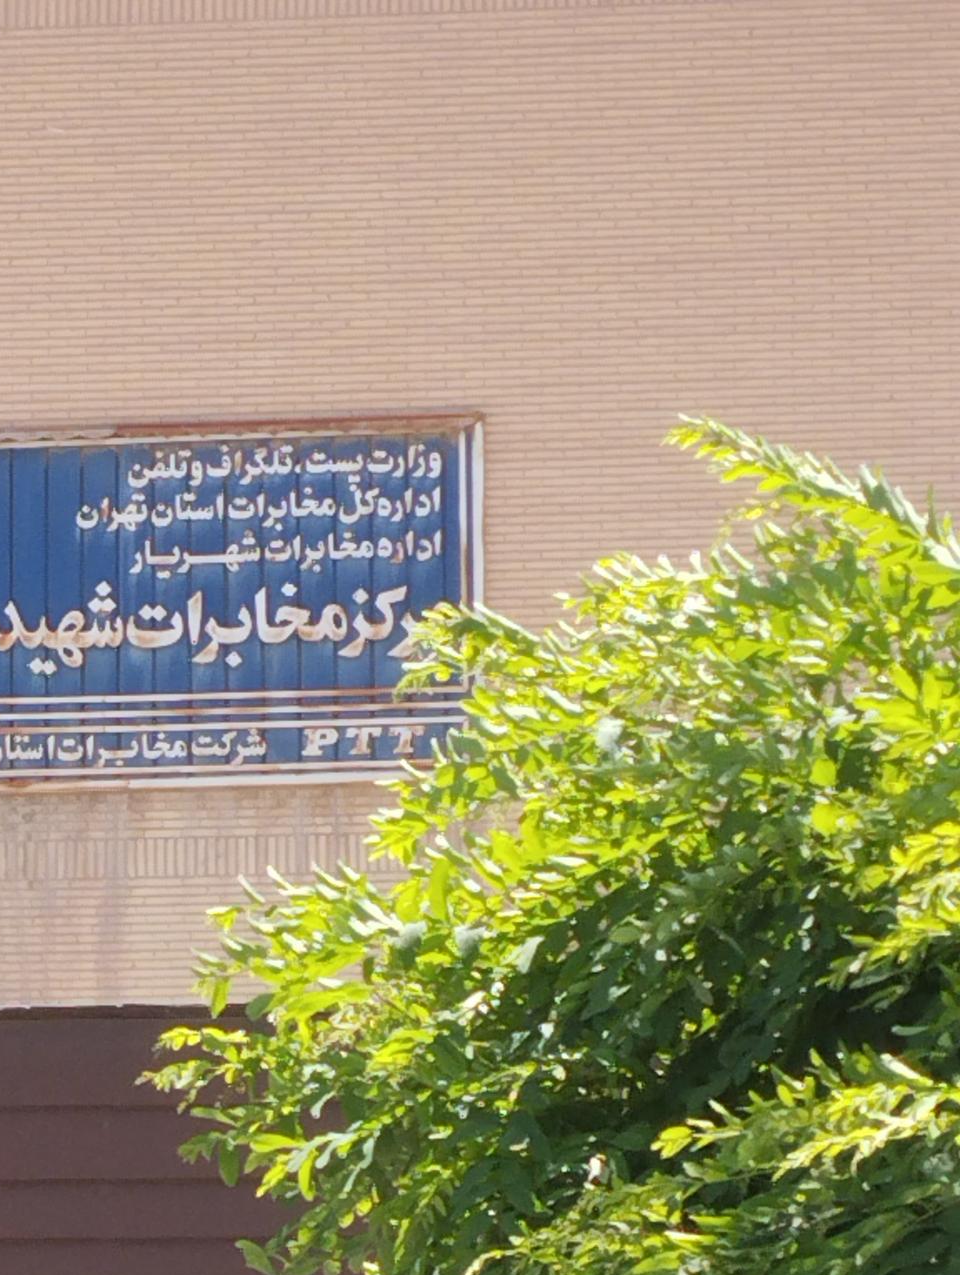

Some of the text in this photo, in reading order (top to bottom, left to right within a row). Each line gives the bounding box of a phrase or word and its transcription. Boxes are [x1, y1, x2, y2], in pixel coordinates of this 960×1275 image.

[205, 444, 293, 484] تلگراف
[367, 445, 442, 479] وزارت
[75, 486, 441, 531] اداره کل مخابرات استان تهران
[264, 530, 374, 573] مخابرات
[376, 530, 441, 562] اداره
[125, 582, 349, 668] مخابرات
[337, 585, 426, 659] رکز
[57, 731, 188, 768] مخابرات
[190, 728, 268, 767] شرکت
[301, 727, 426, 757] PTT
